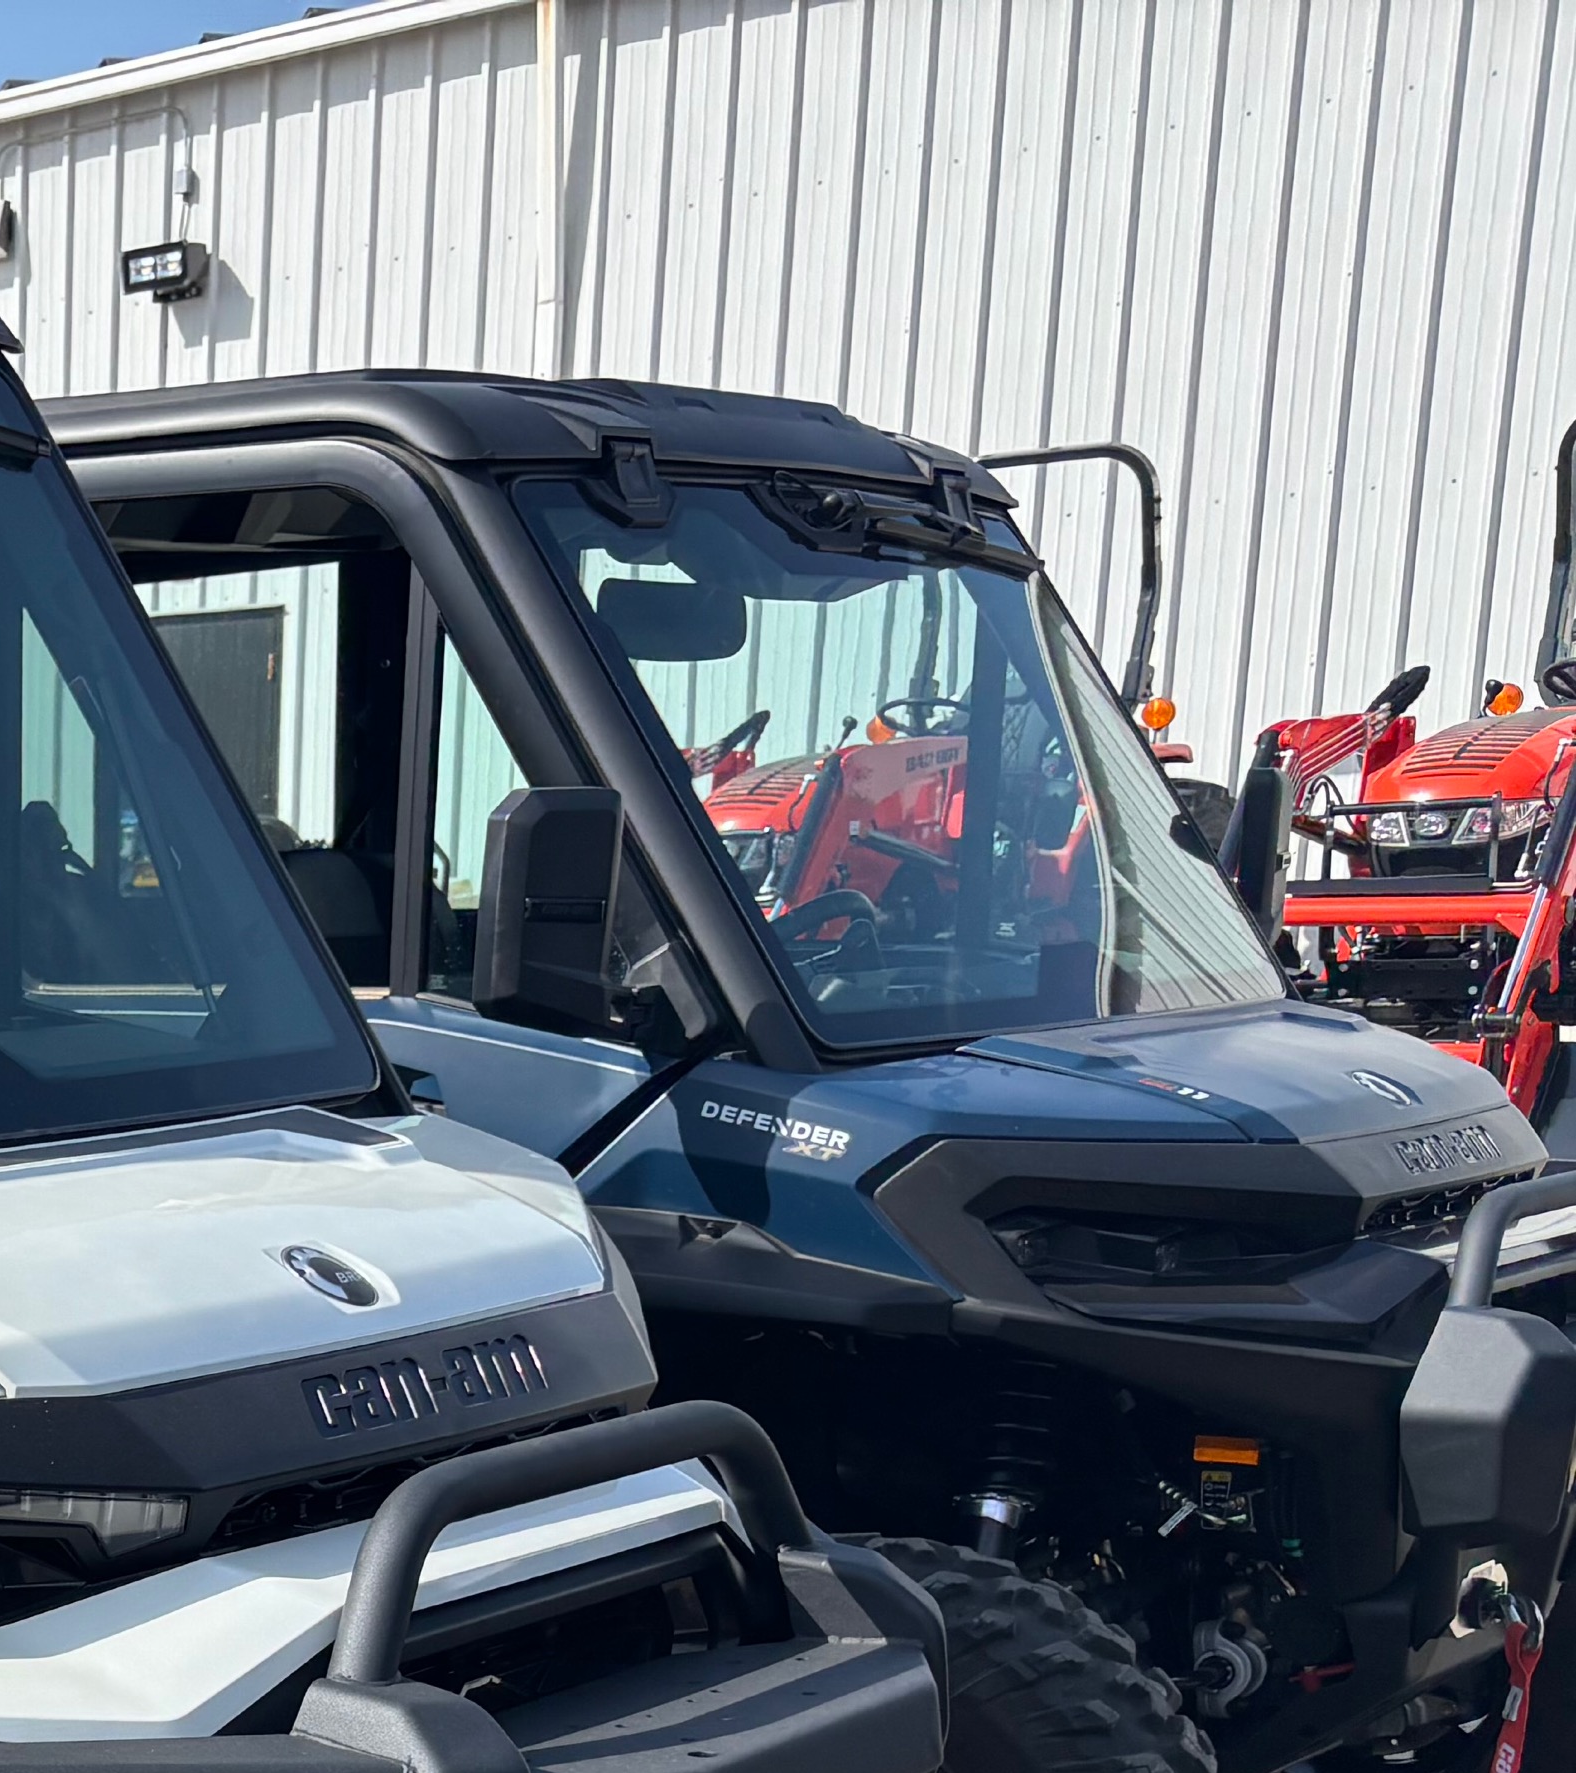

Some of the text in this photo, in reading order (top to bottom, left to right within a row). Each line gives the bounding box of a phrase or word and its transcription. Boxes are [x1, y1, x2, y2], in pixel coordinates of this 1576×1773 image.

[701, 1100, 850, 1150] DEFENDER
[1395, 1125, 1502, 1175] can-am
[782, 1141, 847, 1162] XT
[301, 1333, 549, 1440] can-am
